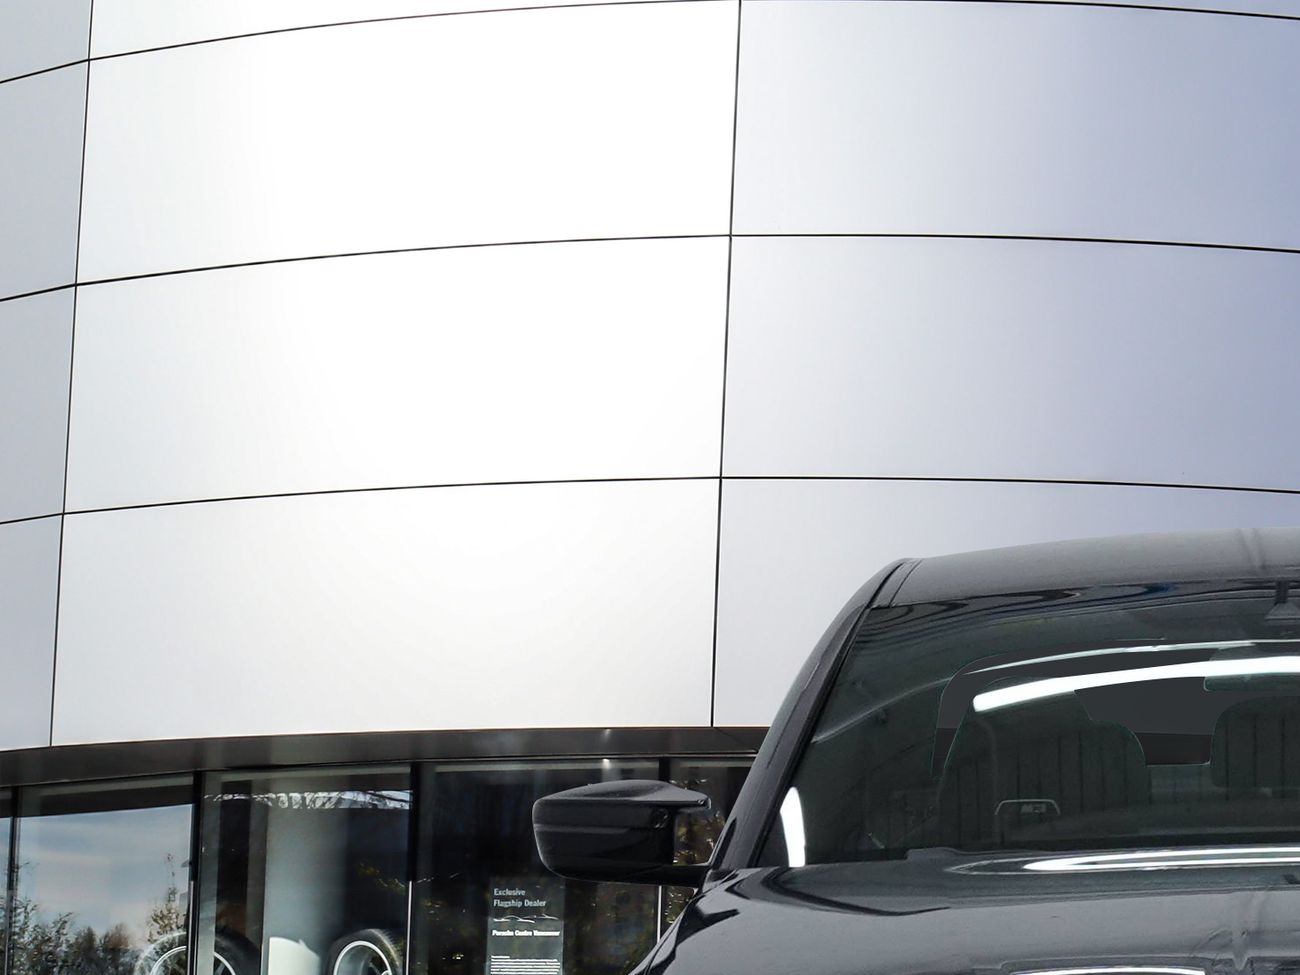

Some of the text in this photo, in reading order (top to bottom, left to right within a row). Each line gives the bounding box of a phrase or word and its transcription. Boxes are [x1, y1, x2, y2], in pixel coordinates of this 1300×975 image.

[493, 888, 526, 896] Exclusive
[493, 899, 546, 908] Flagship Dealer
